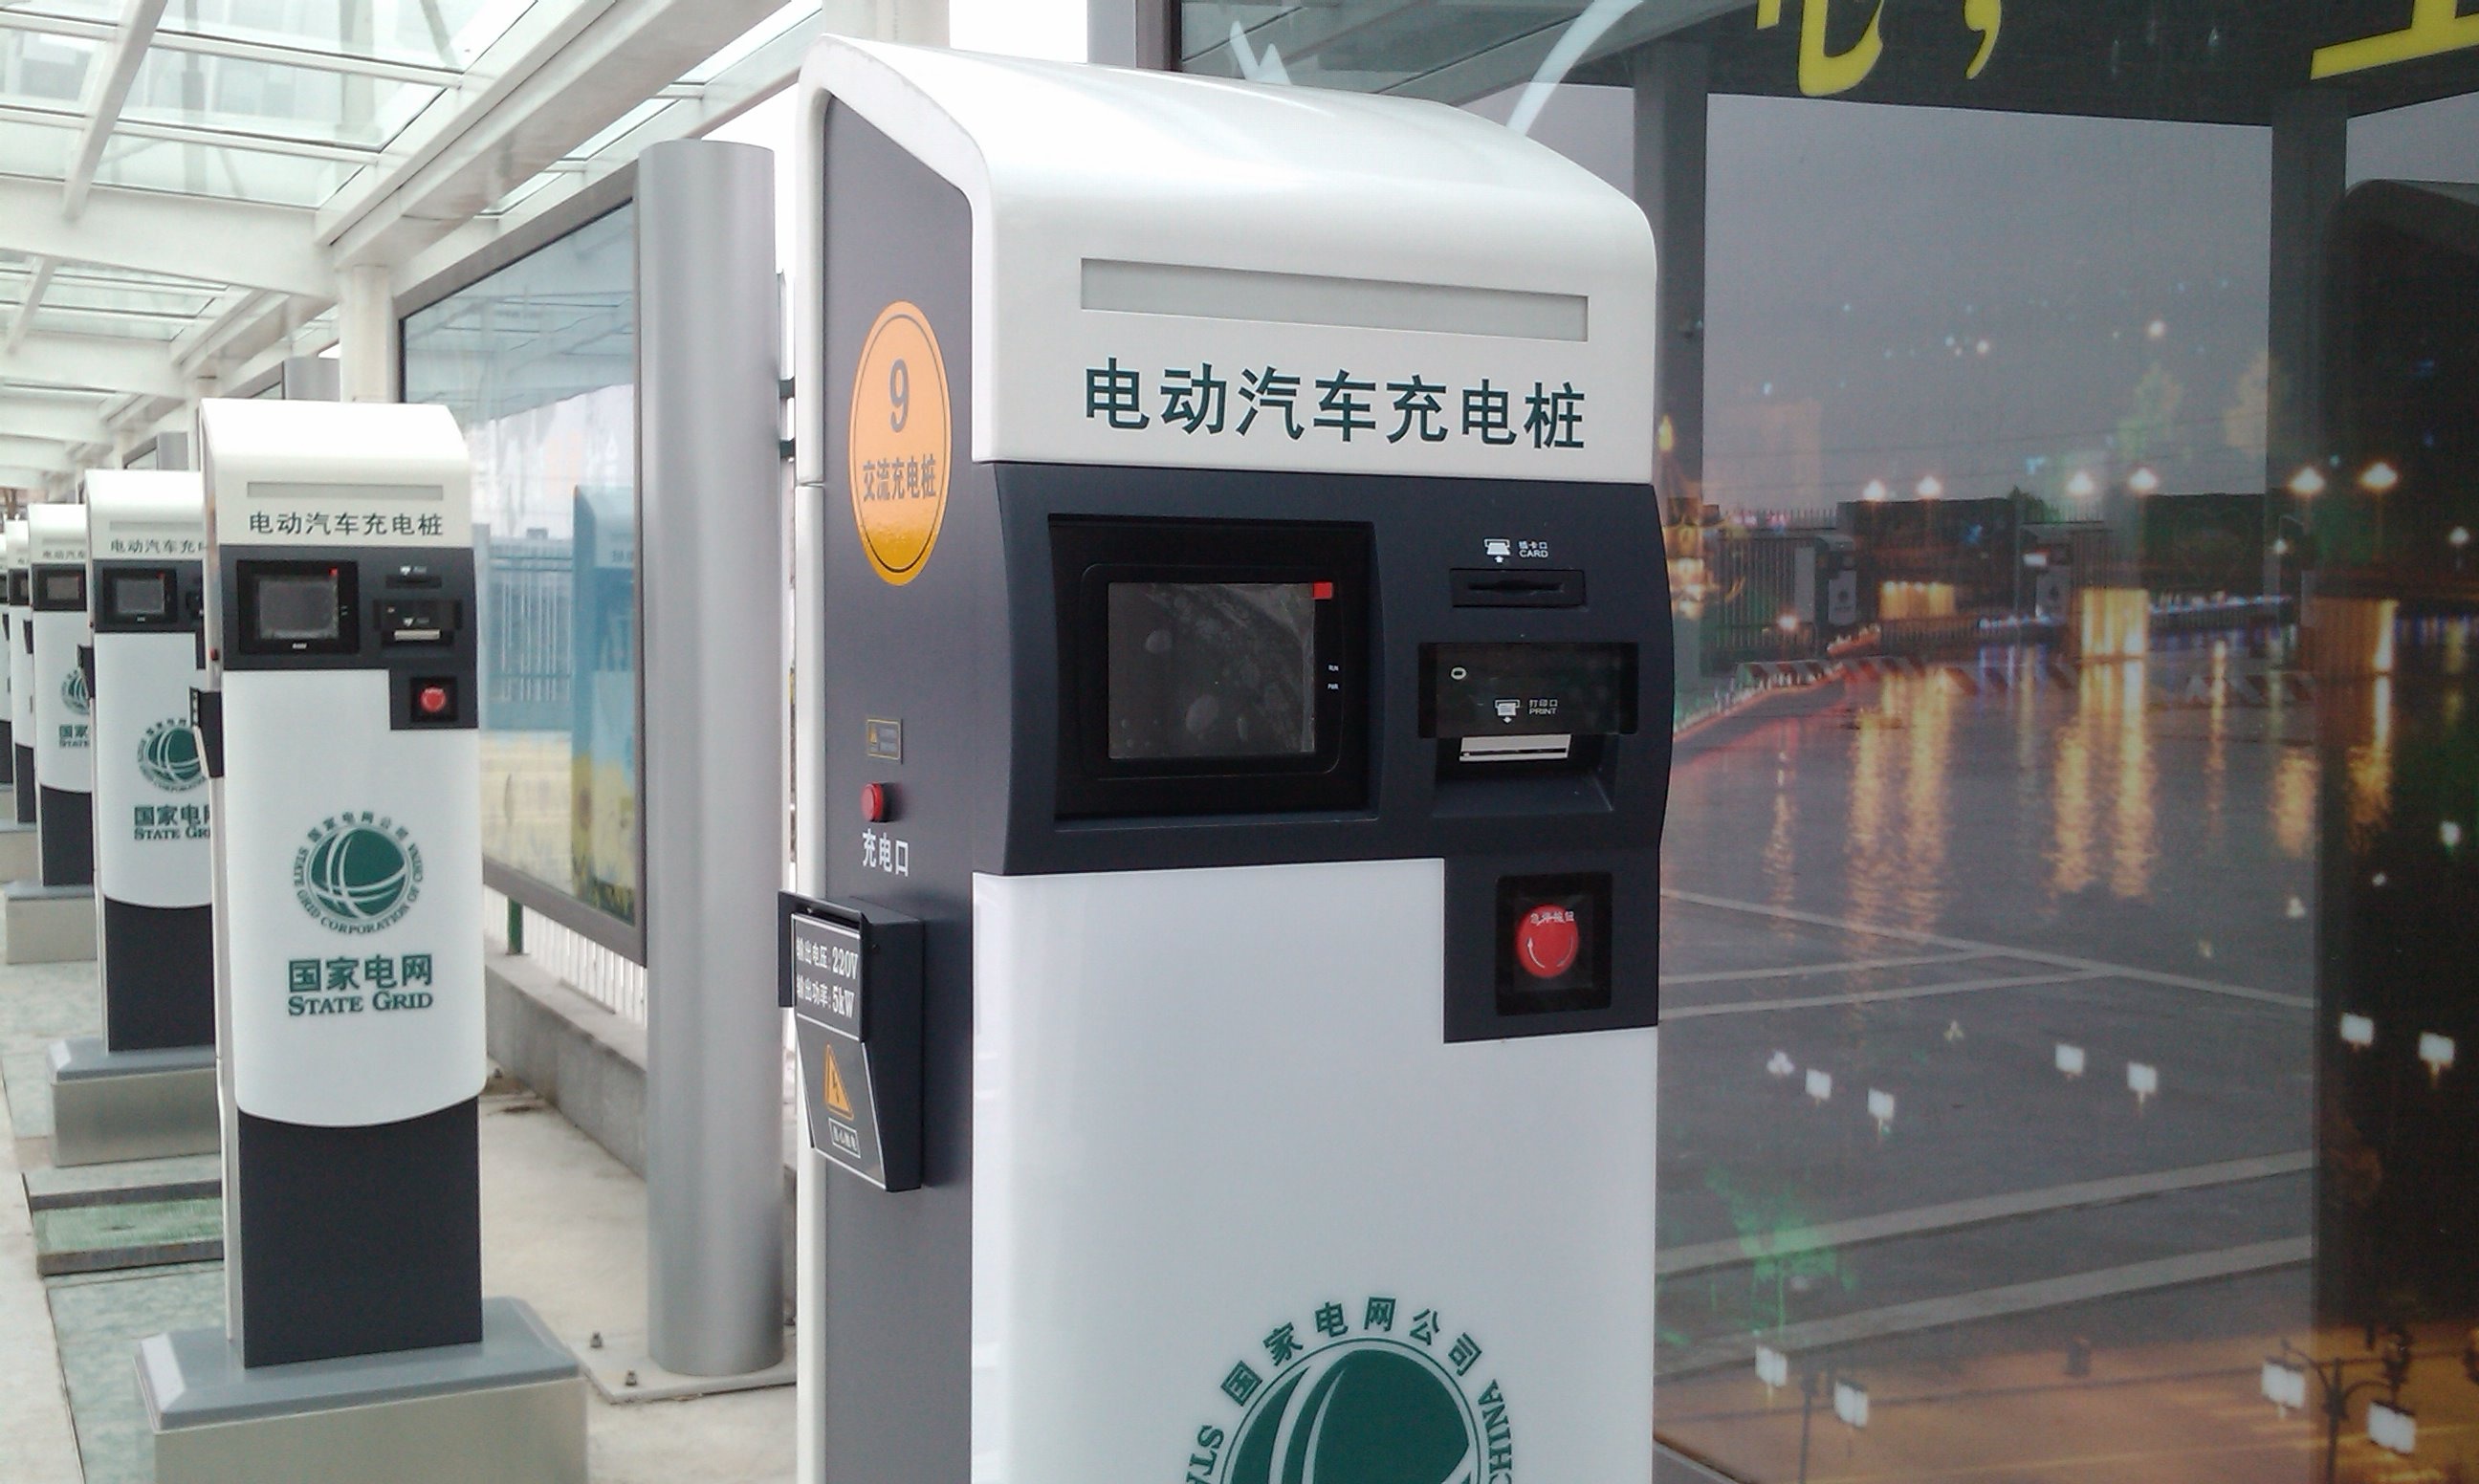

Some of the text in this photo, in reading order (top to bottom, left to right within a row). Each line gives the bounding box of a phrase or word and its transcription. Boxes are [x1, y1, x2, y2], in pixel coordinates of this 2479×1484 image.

[889, 358, 910, 433] 9
[1086, 356, 1586, 449] 电动汽车充电桩
[863, 453, 936, 502] 交流充电桩
[249, 511, 444, 536] 电动汽车充电桩
[1519, 549, 1549, 558] CARD
[134, 826, 180, 840] STATE
[862, 828, 909, 877] 充电口
[289, 954, 432, 993] 国家电网
[288, 991, 433, 1016] STATE GRID
[1220, 1297, 1482, 1407] 国家电网公司
